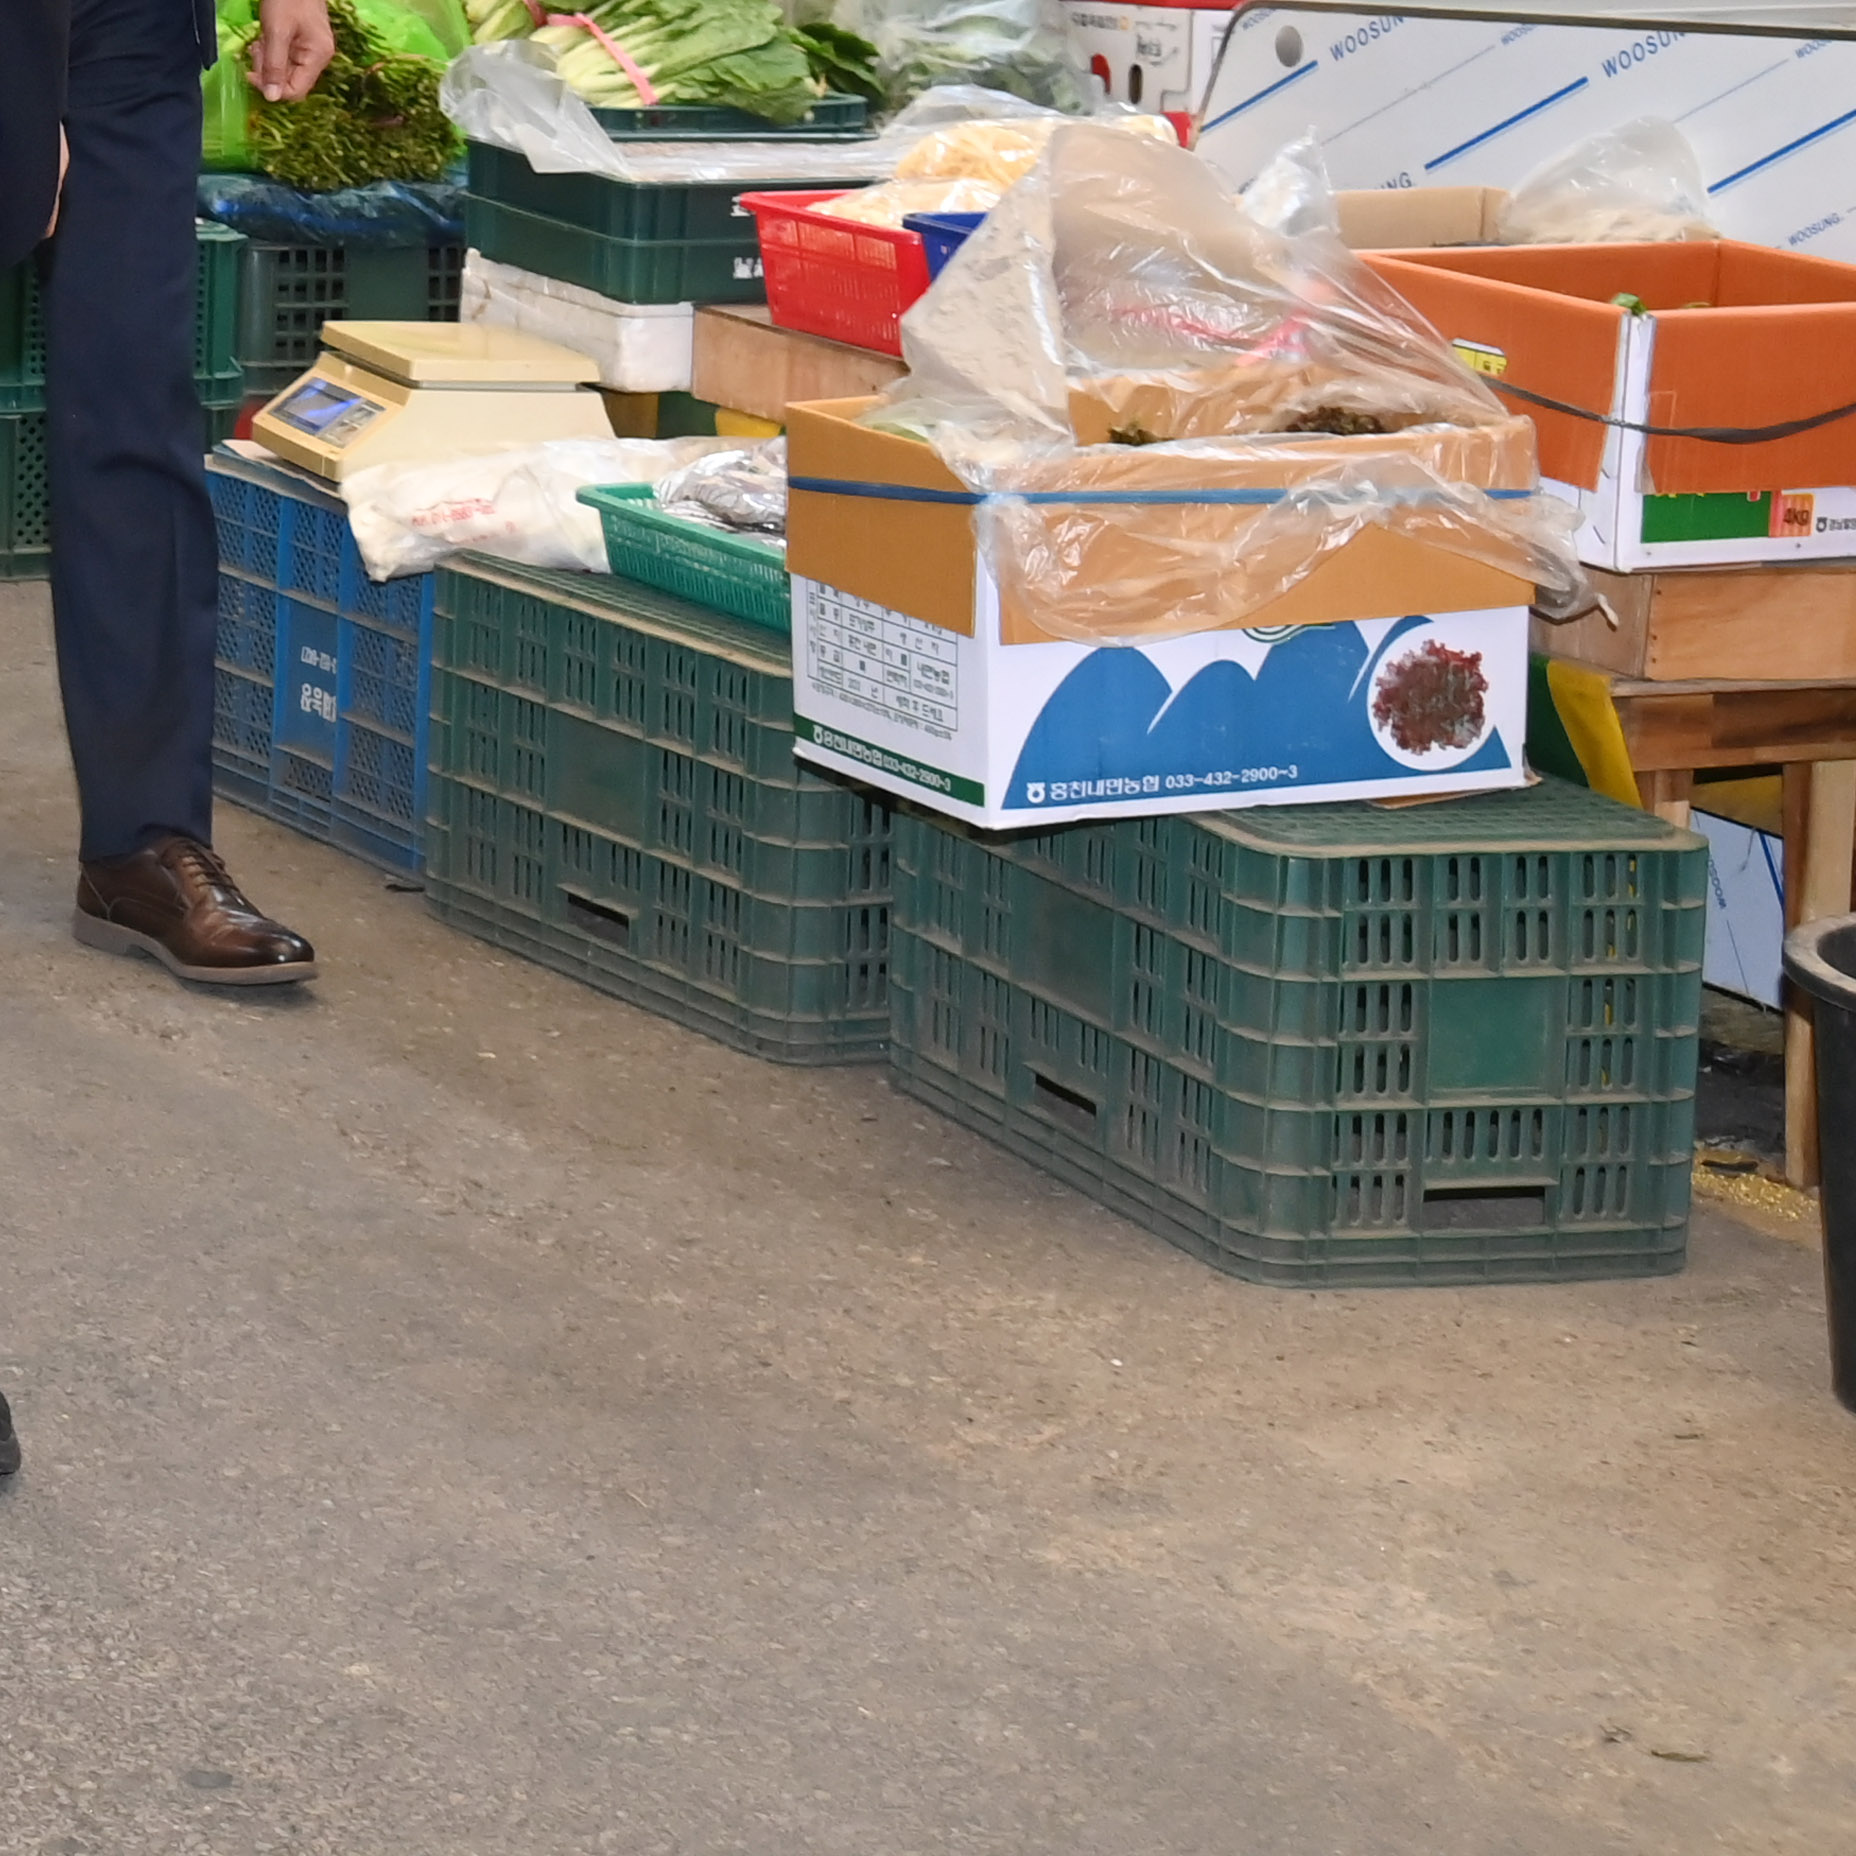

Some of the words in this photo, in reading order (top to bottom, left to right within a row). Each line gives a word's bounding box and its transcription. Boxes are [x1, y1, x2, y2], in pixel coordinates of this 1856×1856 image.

[1330, 15, 1405, 62] WOOSUN
[1601, 31, 1686, 79] WOOSUN
[1049, 775, 1161, 800] 홍천내면농협
